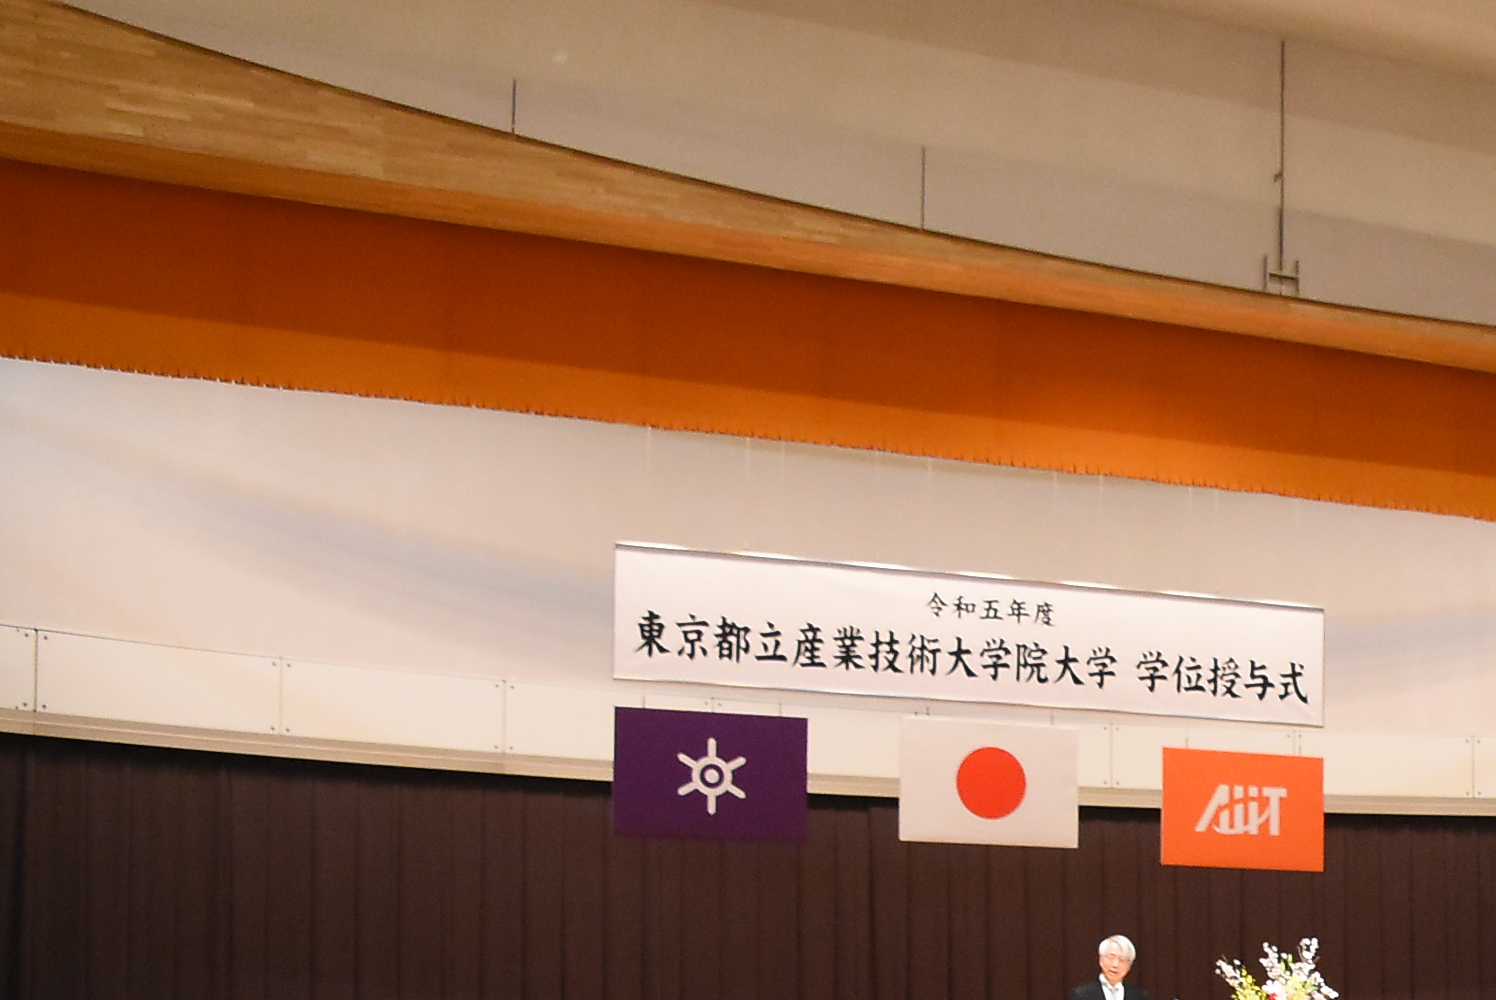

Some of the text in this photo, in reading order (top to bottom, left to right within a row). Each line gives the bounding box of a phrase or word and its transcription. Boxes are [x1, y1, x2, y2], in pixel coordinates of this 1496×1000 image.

[927, 591, 1055, 627] 令和五年度
[635, 609, 1309, 705] 東京都立産業技術大学院大学 学位授与式
